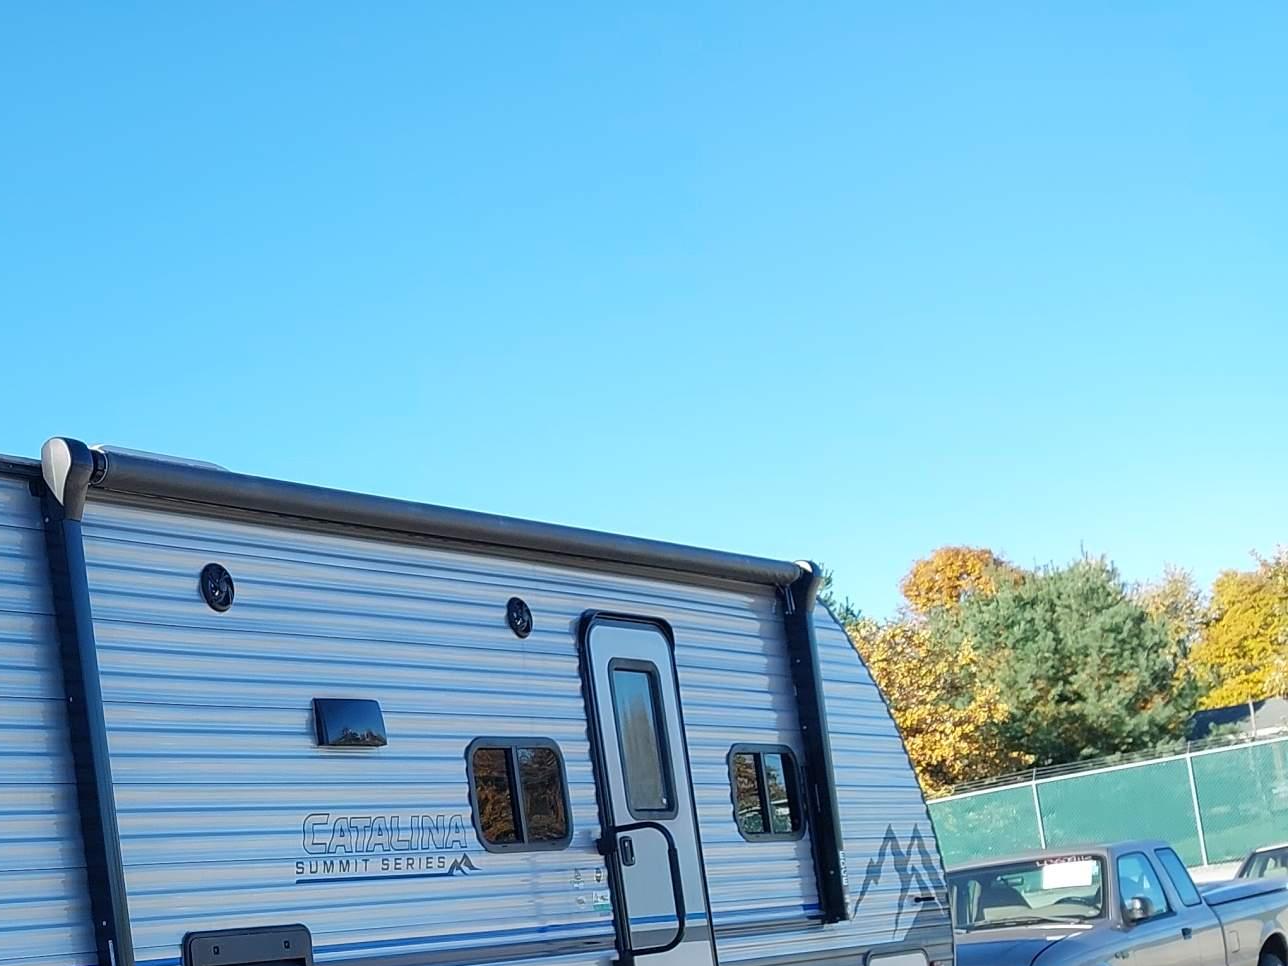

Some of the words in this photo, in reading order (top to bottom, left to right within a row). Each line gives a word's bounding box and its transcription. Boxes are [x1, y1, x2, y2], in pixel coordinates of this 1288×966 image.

[302, 813, 468, 855] CATALINA
[295, 858, 370, 875] SUMMIT
[381, 856, 446, 871] SERIES
